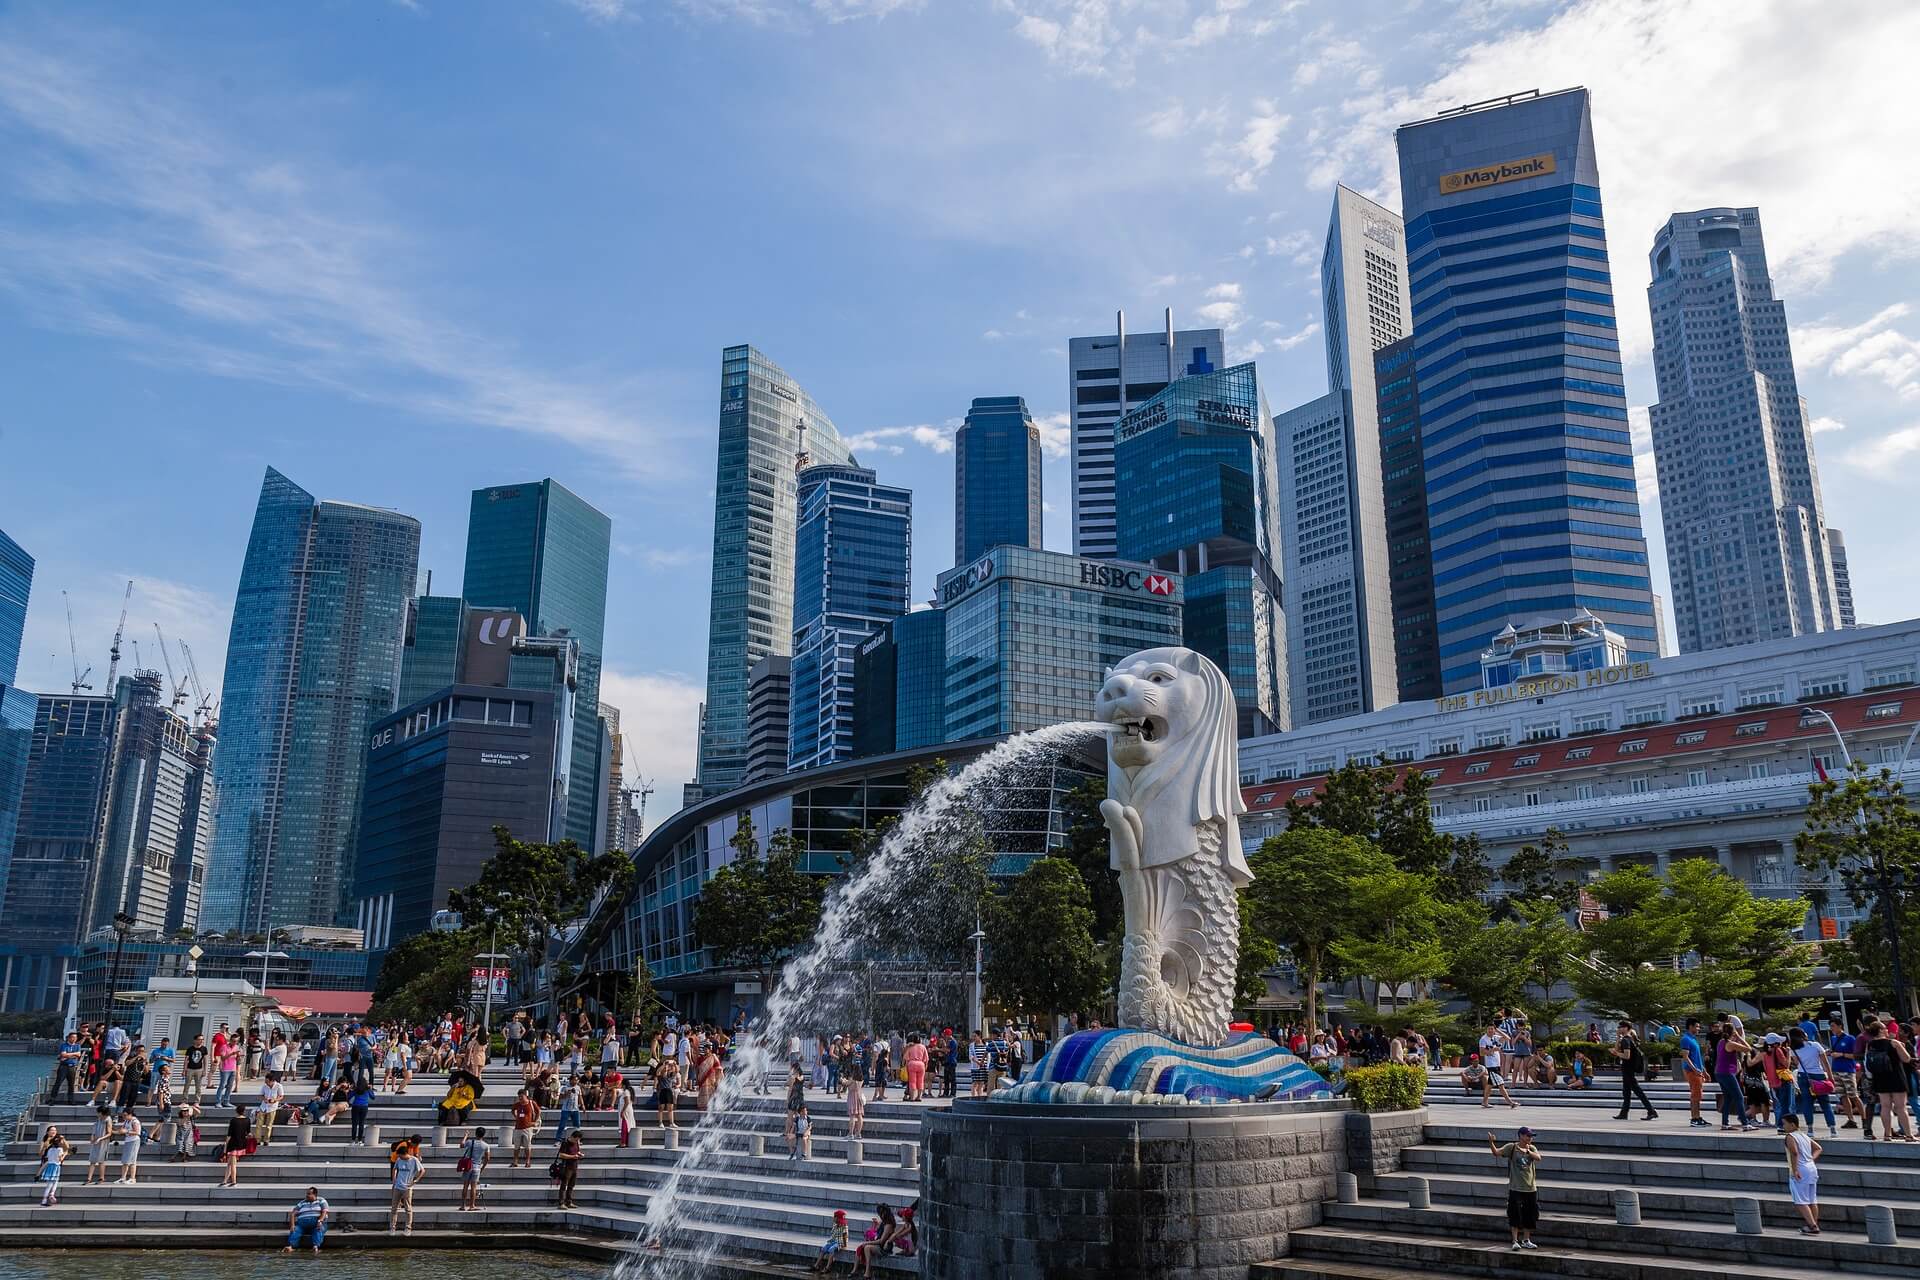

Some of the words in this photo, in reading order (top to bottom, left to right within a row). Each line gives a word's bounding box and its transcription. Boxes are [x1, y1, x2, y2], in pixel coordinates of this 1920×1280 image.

[1463, 159, 1545, 185] Maybank
[722, 400, 744, 412] ANZ
[1121, 401, 1165, 428] STRAITS
[1198, 399, 1250, 416] STRAITS
[1121, 412, 1168, 439] TRADING
[1195, 410, 1252, 429] TRADING
[944, 565, 977, 604] HSBC
[1080, 562, 1141, 591] HSBC
[1435, 694, 1468, 712] THE
[1474, 675, 1578, 705] FULLERTON
[1586, 661, 1655, 687] HOTEL
[371, 728, 393, 750] OUE
